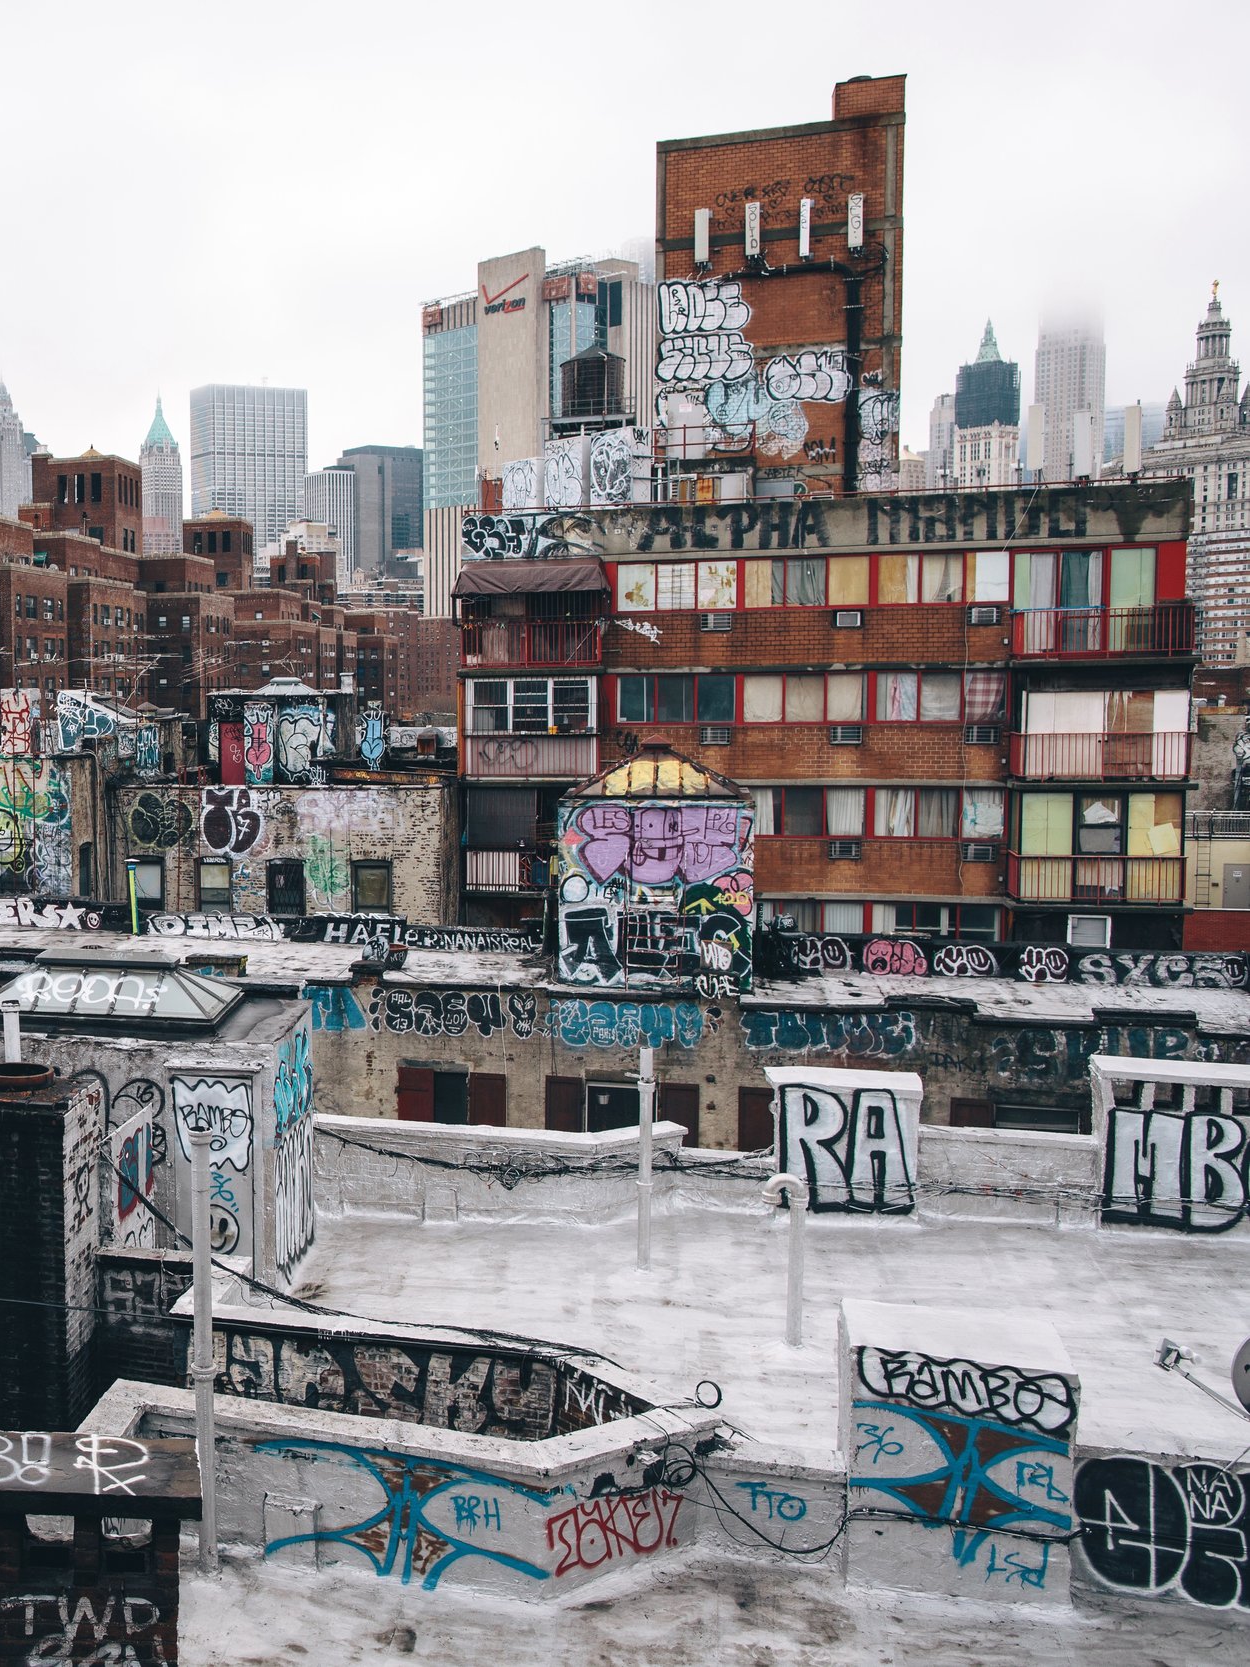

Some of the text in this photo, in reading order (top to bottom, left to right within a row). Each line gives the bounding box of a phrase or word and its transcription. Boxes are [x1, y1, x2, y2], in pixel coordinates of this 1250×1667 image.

[484, 297, 526, 315] verizon
[637, 500, 830, 551] ALPHA
[591, 810, 630, 830] LES
[778, 1083, 916, 1216] RA
